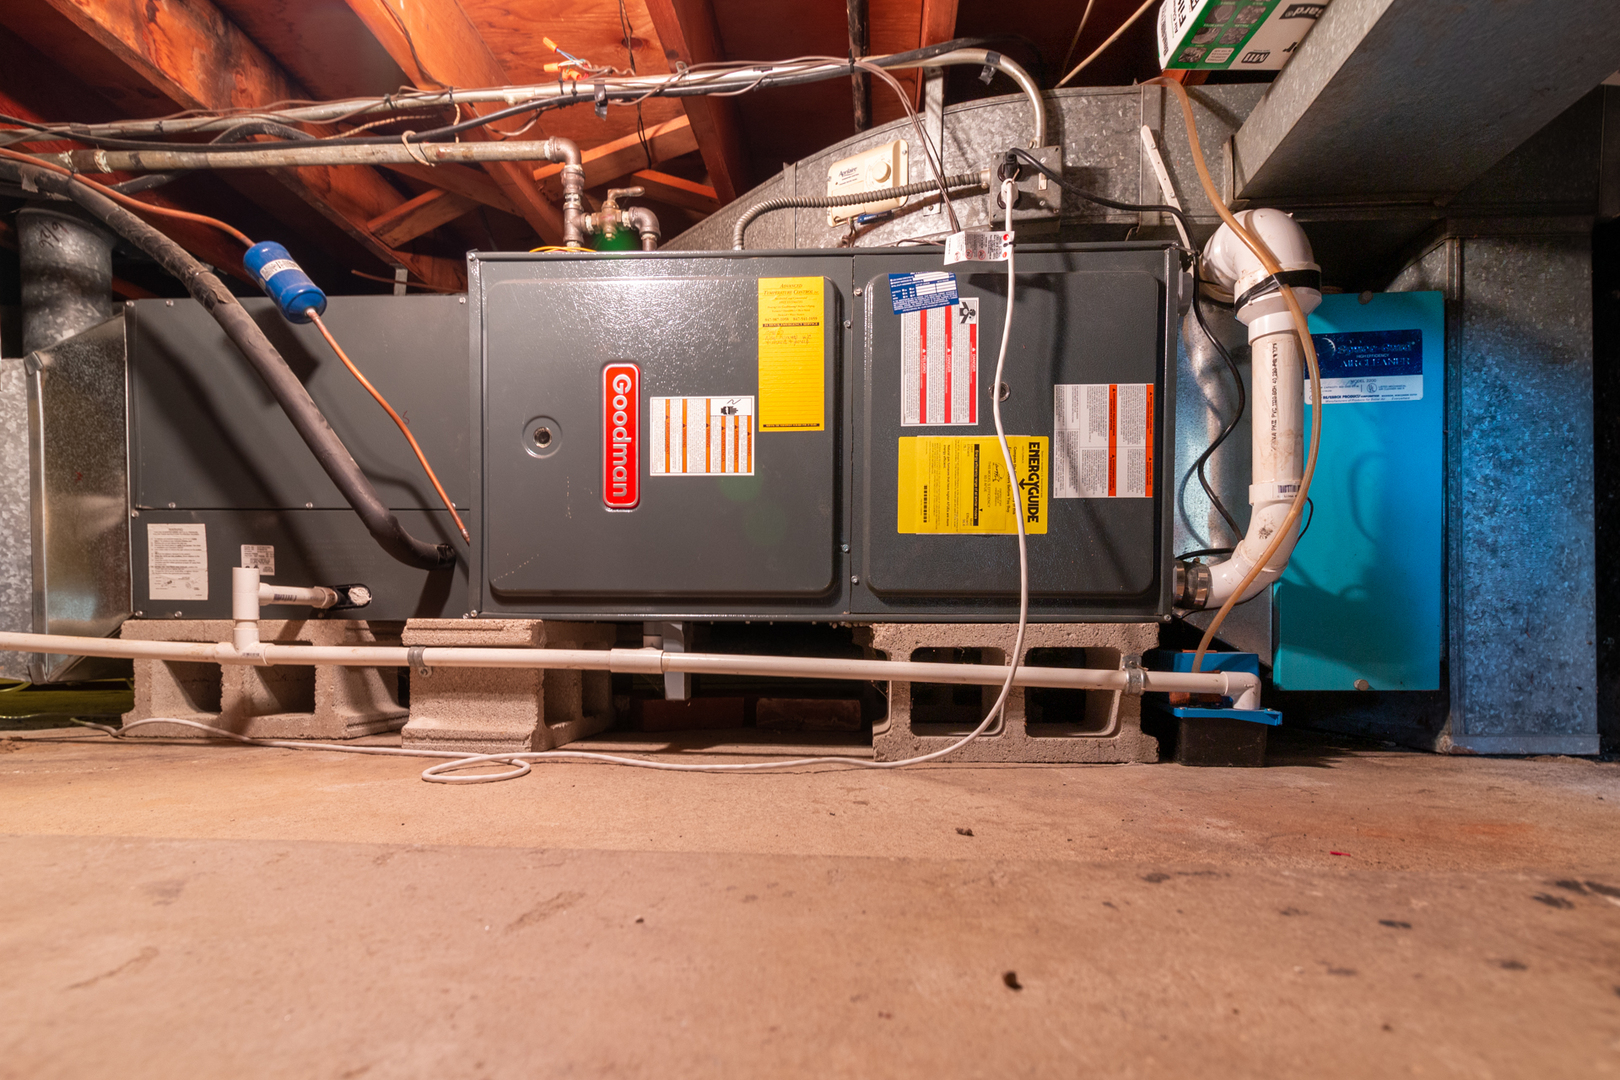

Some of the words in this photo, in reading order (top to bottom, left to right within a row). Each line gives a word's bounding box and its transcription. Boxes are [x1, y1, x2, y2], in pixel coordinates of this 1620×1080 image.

[1341, 359, 1358, 367] AIR
[1358, 358, 1410, 367] CLEANER
[612, 374, 632, 497] Goodman
[1027, 442, 1040, 523] ENERGYGUIDE
